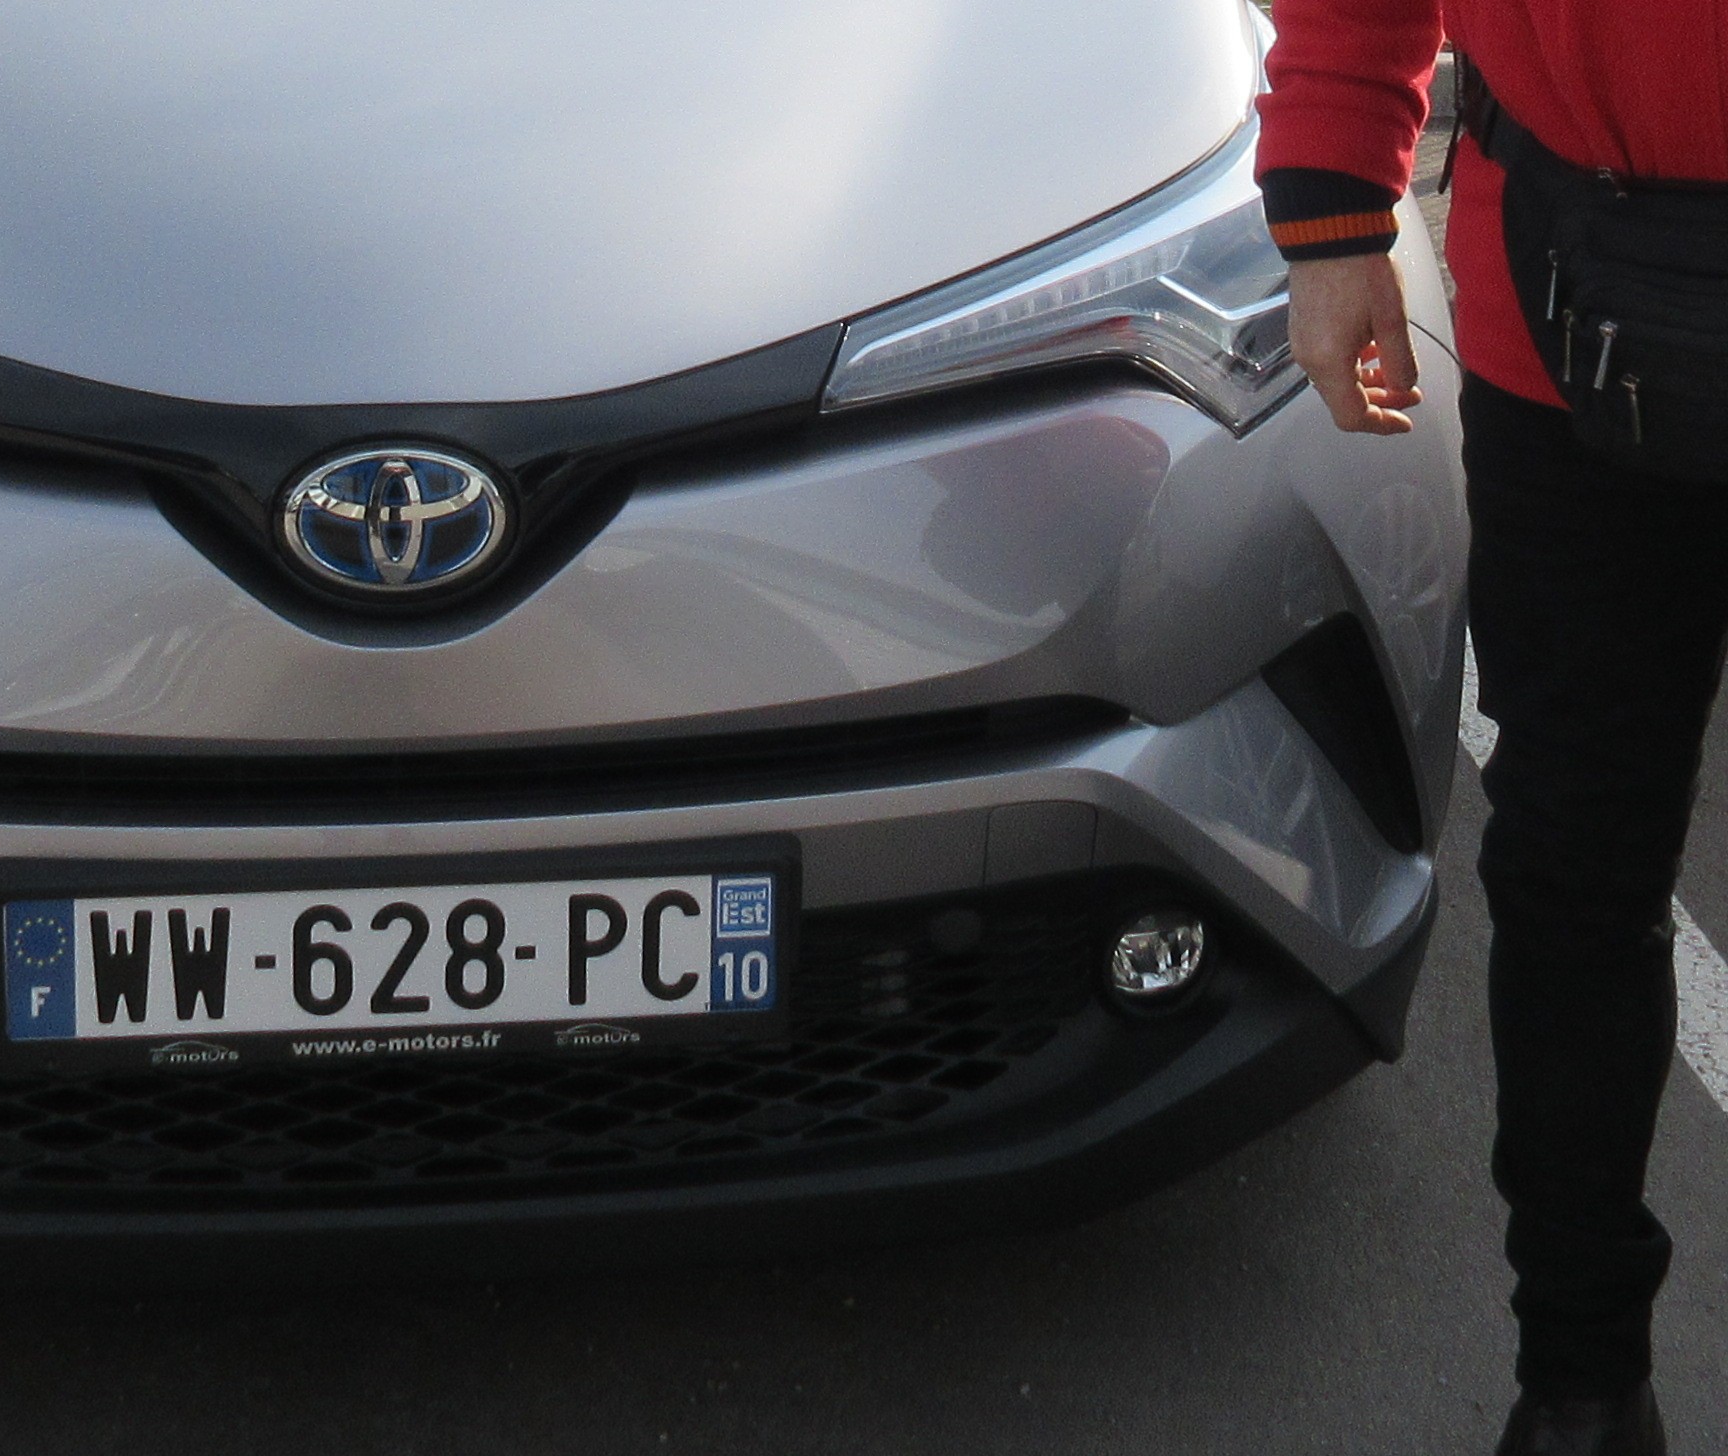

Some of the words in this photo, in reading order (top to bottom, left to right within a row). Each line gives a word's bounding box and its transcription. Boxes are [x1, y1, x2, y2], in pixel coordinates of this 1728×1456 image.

[722, 887, 768, 901] Grand
[722, 902, 767, 924] Est
[718, 950, 769, 1002] 10
[29, 985, 52, 1018] F
[292, 1029, 503, 1056] www.e-motors.fr
